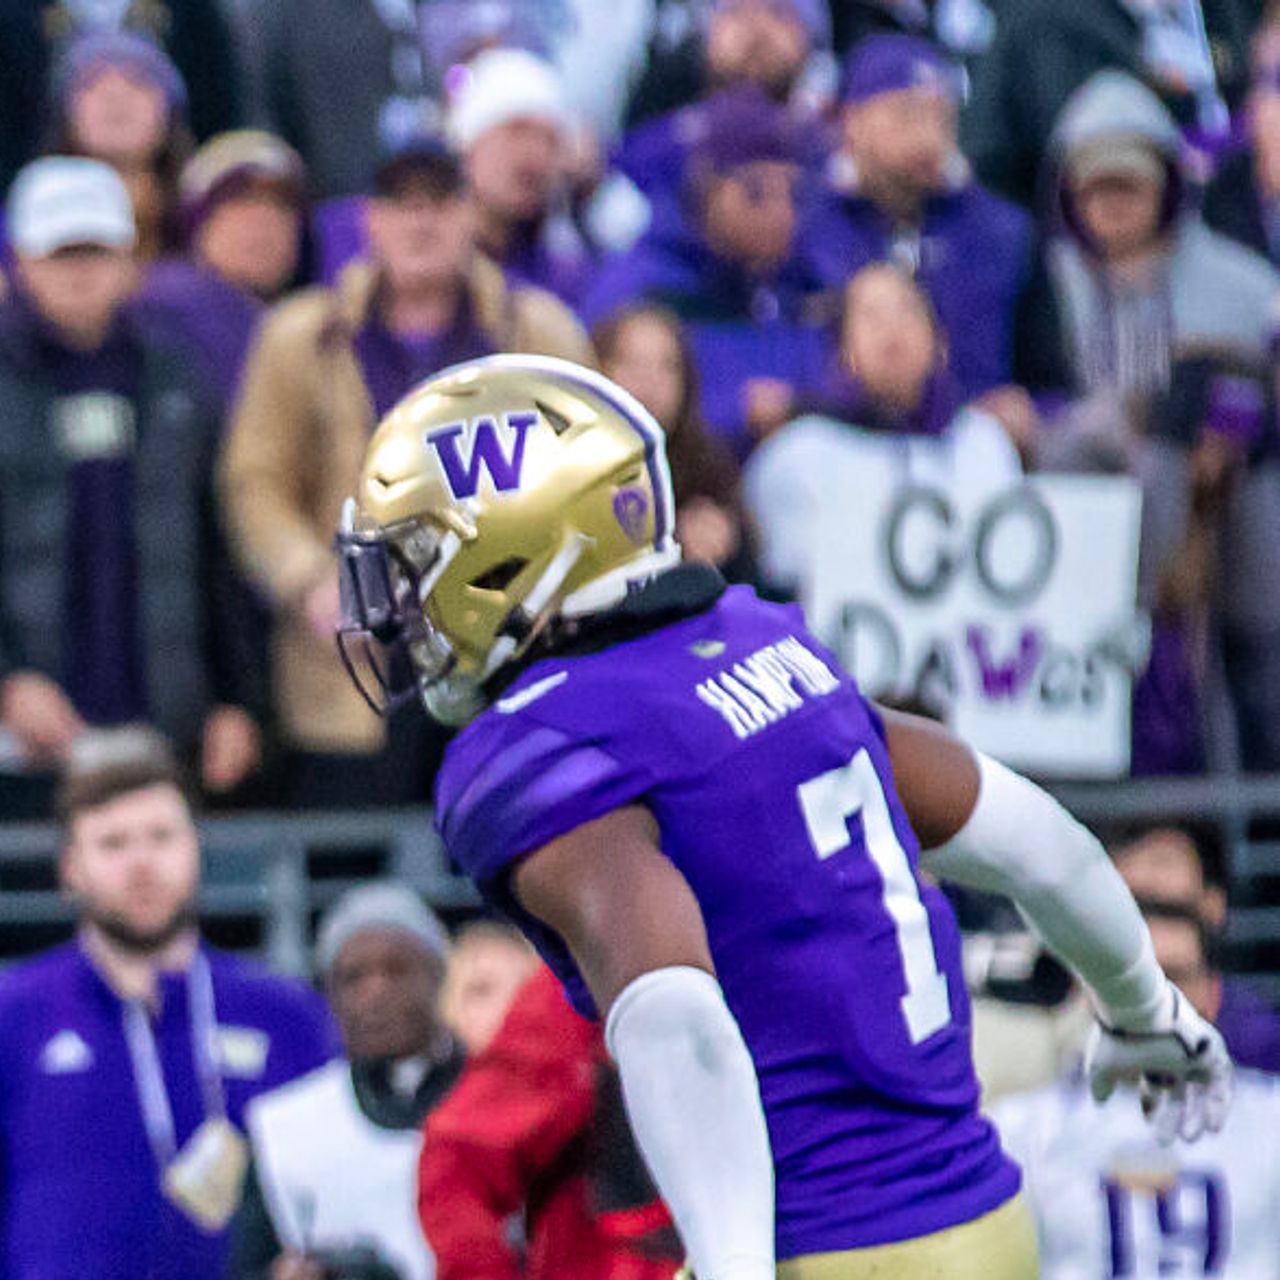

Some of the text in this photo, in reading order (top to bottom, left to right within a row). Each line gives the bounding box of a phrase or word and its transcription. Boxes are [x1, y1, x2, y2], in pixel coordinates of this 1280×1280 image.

[425, 411, 538, 500] W
[882, 484, 1058, 608] GO
[796, 746, 952, 1046] 7
